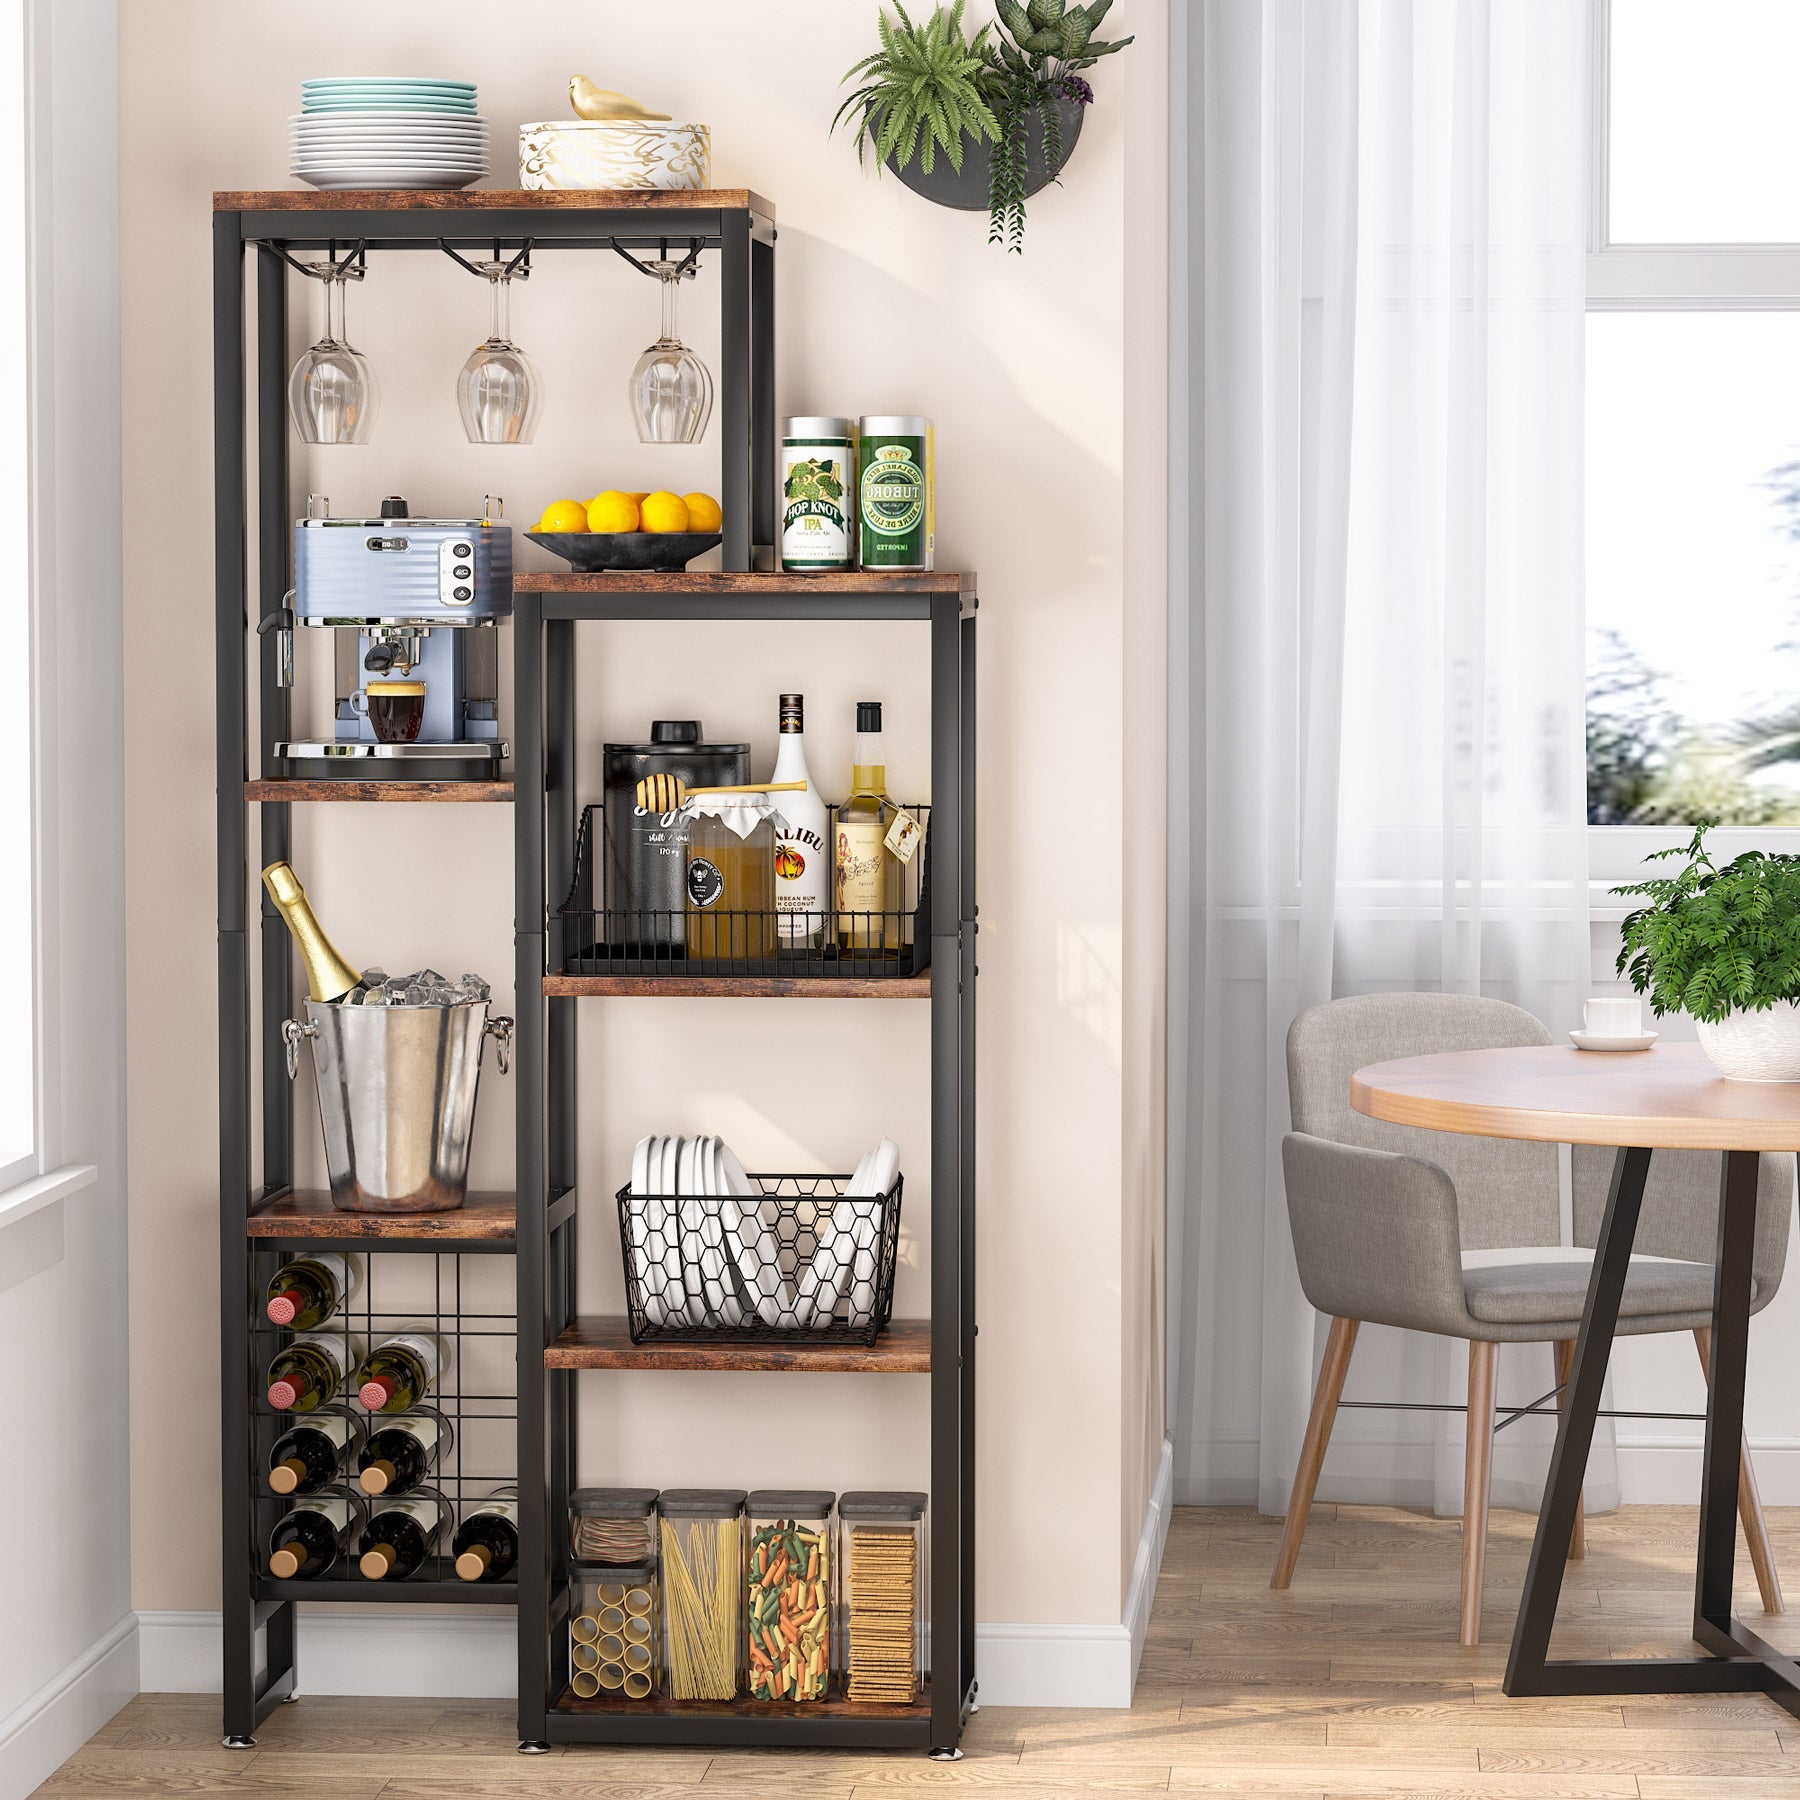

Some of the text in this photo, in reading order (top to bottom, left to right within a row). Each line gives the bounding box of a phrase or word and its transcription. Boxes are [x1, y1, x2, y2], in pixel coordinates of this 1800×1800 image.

[788, 501, 839, 521] HOP KNOT
[804, 518, 822, 531] IPA
[776, 827, 824, 849] LIBU
